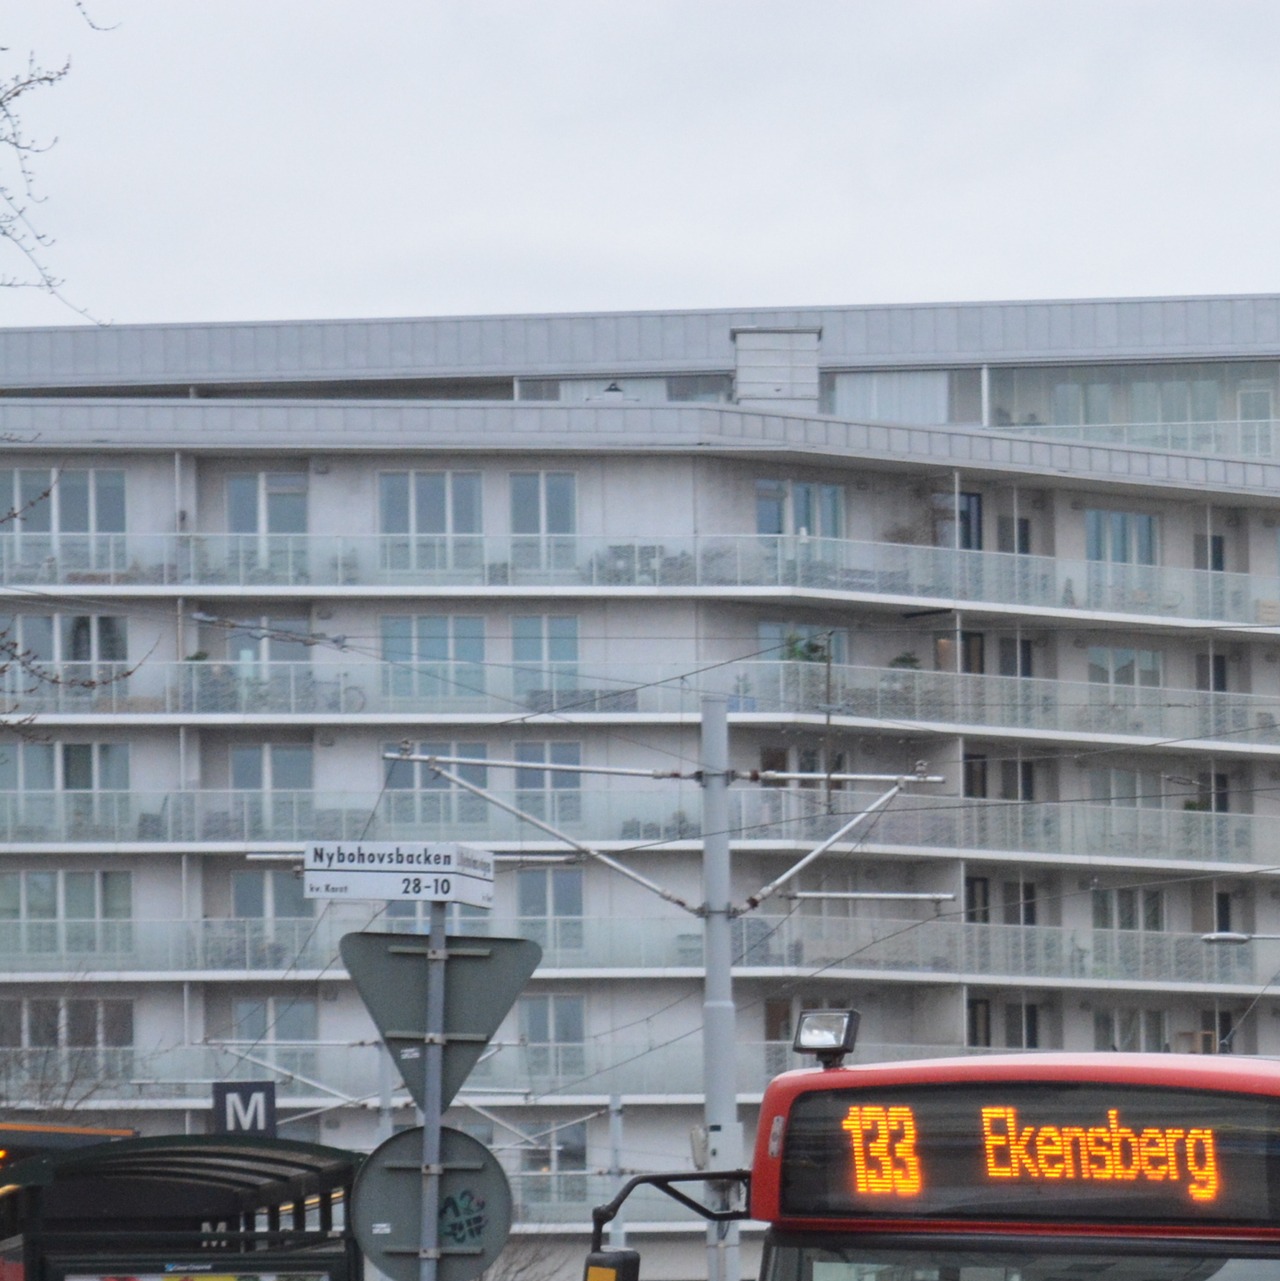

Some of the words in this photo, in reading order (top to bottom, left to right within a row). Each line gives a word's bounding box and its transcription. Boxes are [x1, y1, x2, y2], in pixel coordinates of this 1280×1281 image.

[313, 845, 452, 868] Nybohovsbacken
[402, 878, 451, 895] 28-10
[225, 1091, 266, 1132] M
[842, 1106, 920, 1193] 133
[981, 1107, 1217, 1200] Ekensberg
